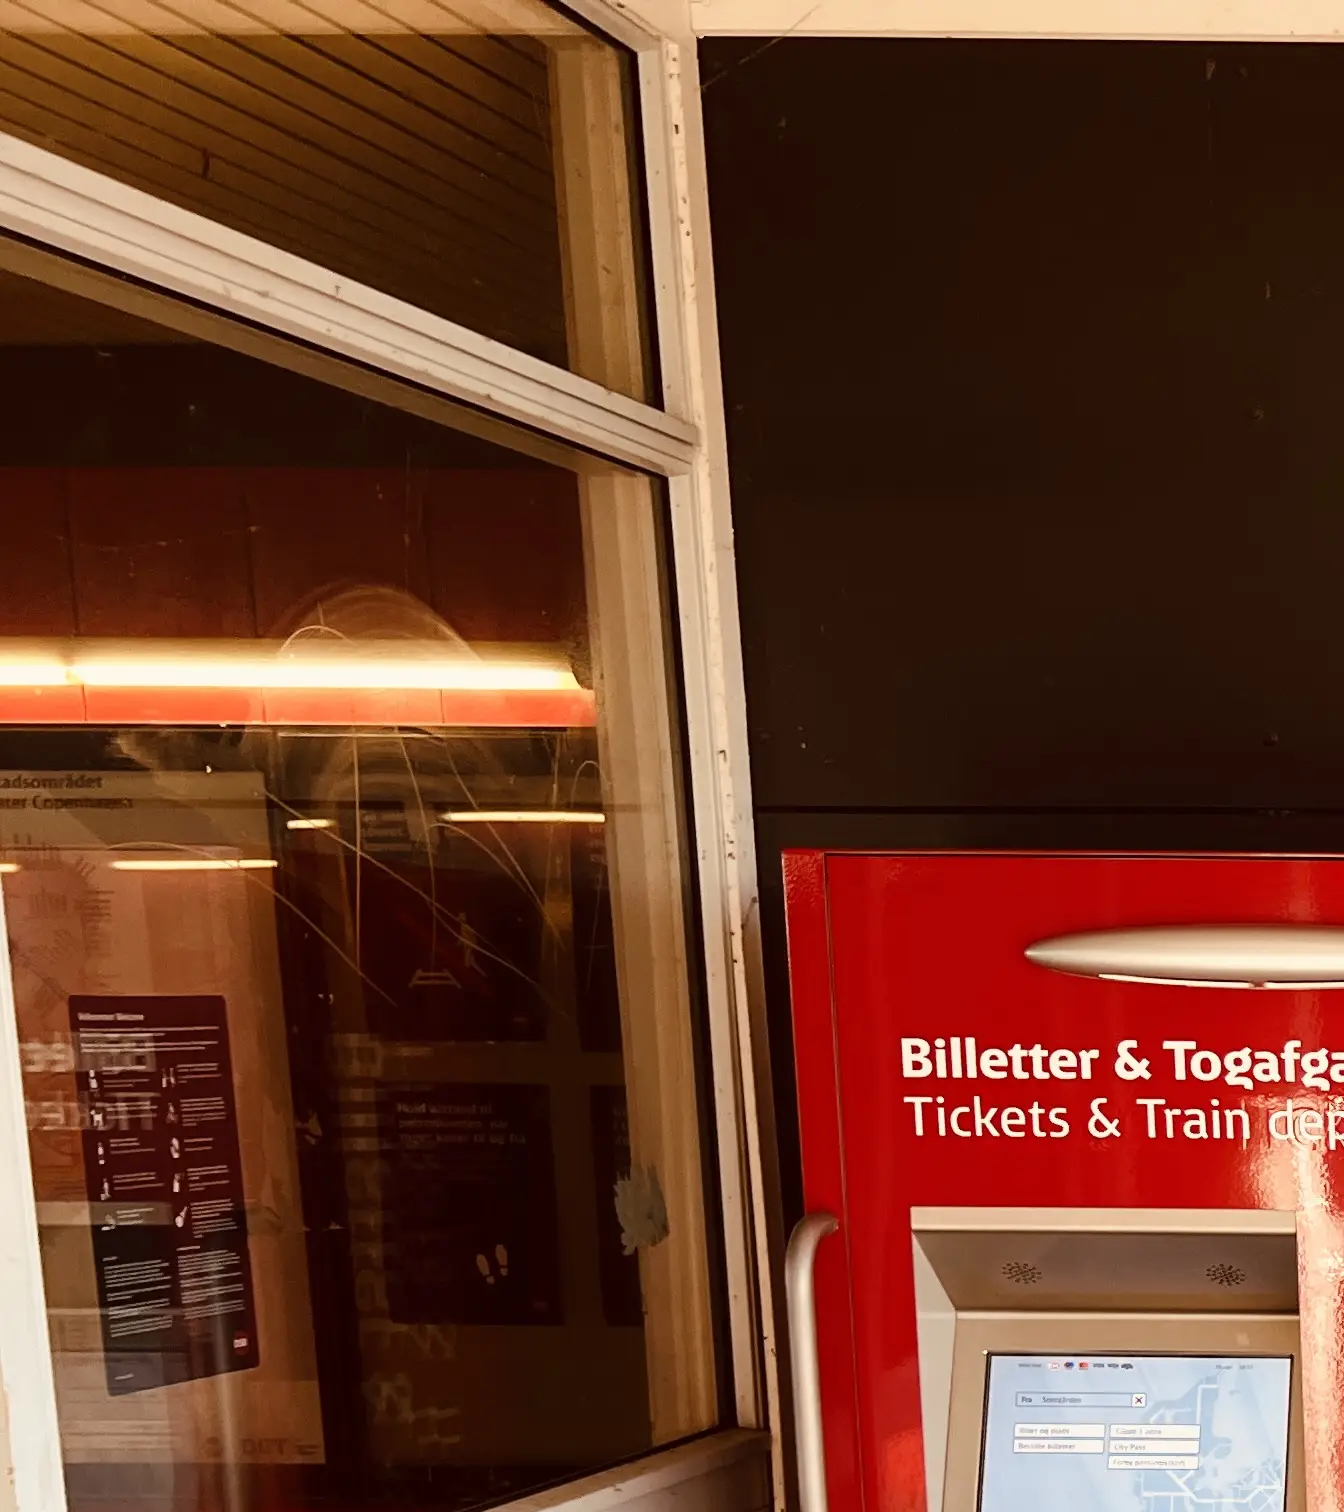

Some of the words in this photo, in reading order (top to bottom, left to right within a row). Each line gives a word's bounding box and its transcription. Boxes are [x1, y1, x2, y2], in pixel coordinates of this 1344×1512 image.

[901, 1037, 1099, 1081] Billetter
[1114, 1039, 1151, 1081] &
[904, 1095, 1069, 1138] Tickets
[1088, 1097, 1121, 1139] &
[1139, 1098, 1250, 1140] Train
